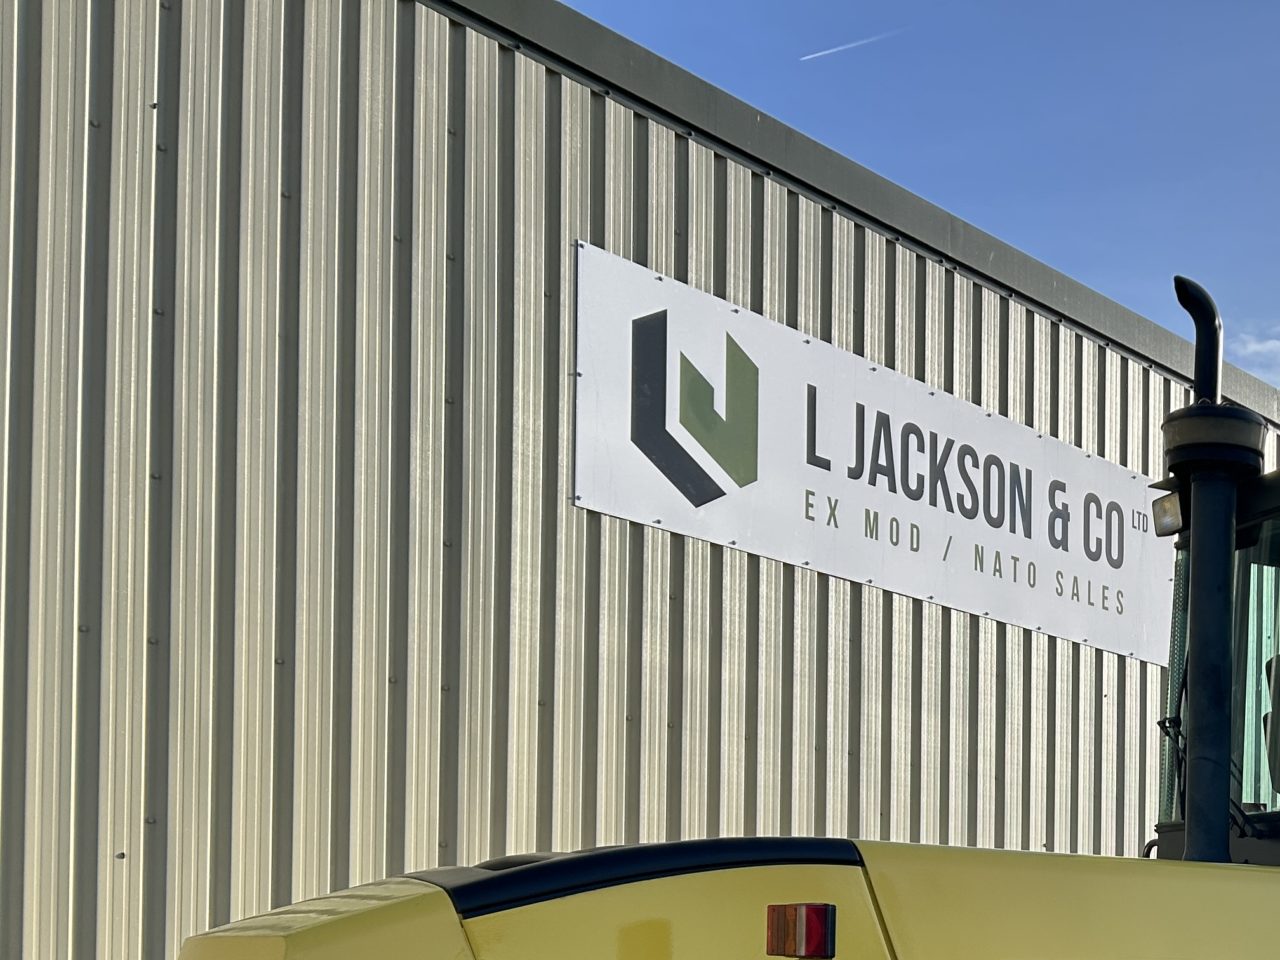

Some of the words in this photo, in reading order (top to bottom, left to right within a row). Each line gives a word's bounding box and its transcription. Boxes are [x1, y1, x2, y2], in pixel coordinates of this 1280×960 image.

[804, 488, 839, 529] EX
[864, 507, 921, 553] MOD
[942, 535, 953, 562] /
[974, 543, 1037, 589] NATO
[1055, 569, 1124, 616] SALES
[806, 383, 832, 472] L
[846, 401, 1033, 540] JACKSON
[1047, 479, 1071, 553] &
[1083, 492, 1125, 570] CO
[1131, 508, 1149, 534] LTD
